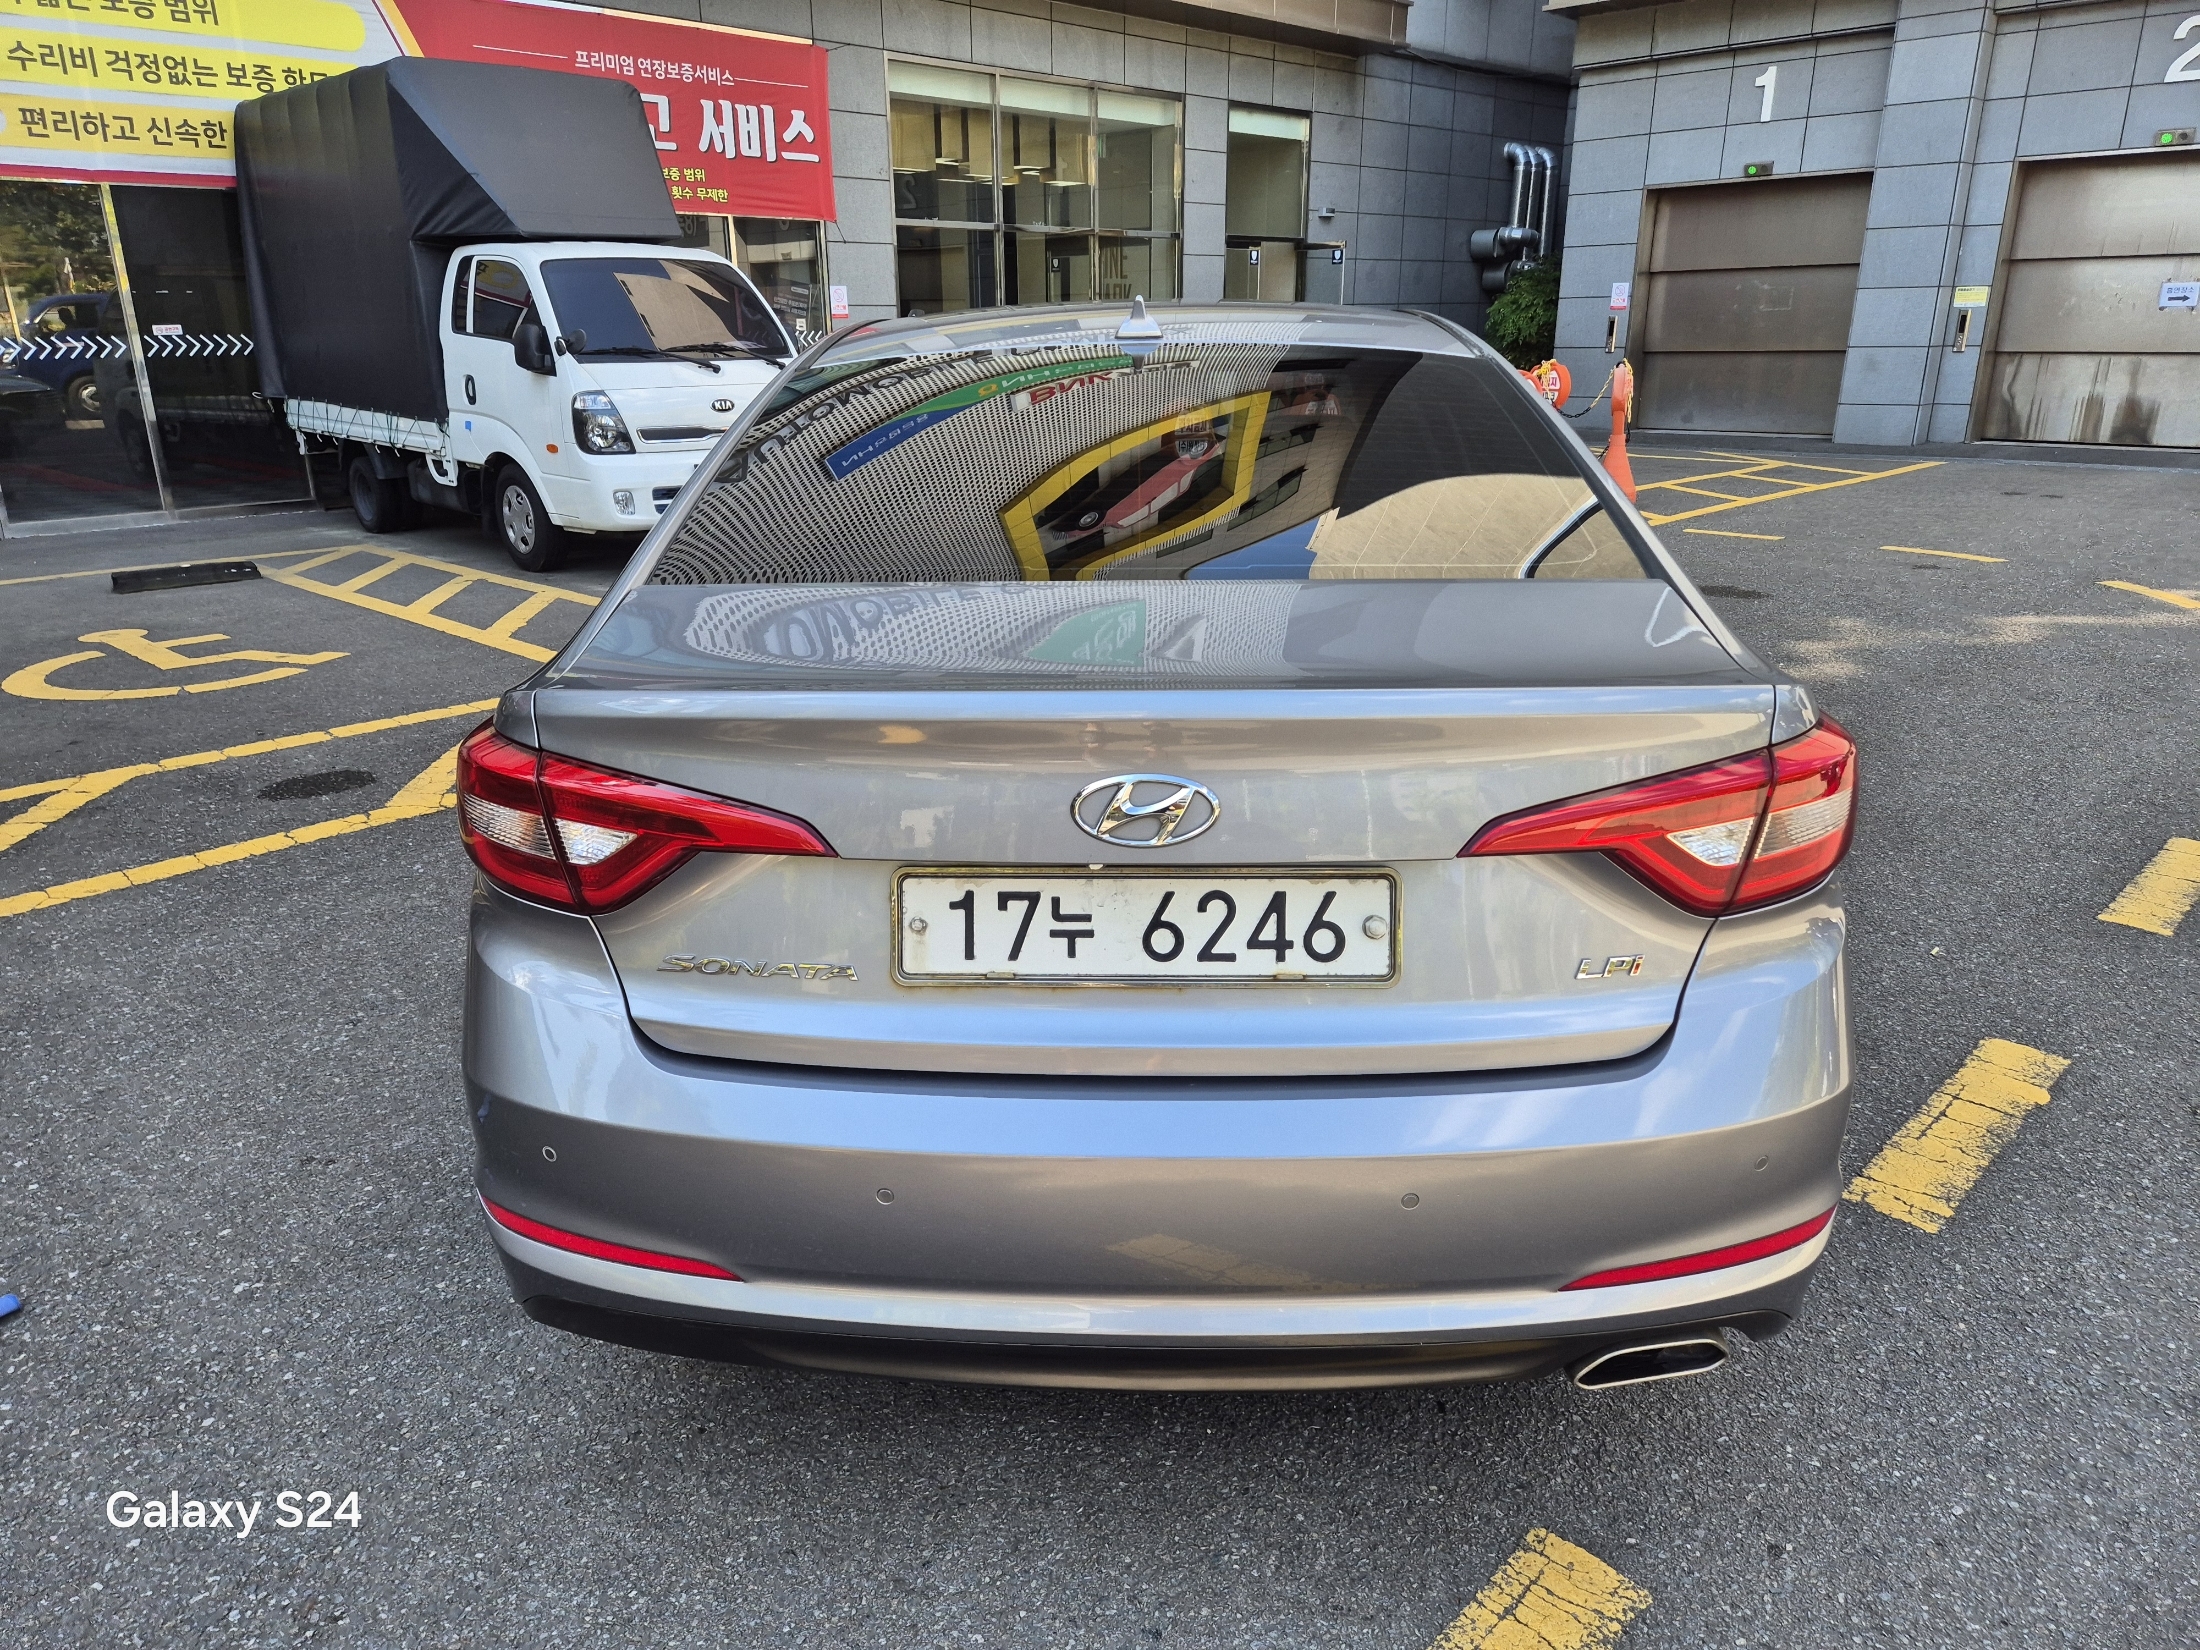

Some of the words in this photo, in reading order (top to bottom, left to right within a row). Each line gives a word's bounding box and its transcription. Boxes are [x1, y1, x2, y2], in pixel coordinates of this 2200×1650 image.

[164, 0, 220, 26] 범위
[7, 39, 99, 78] 수리비
[105, 47, 219, 89] 걱정없는
[226, 61, 277, 94] 보증
[2163, 14, 2200, 84] 2
[574, 50, 635, 76] 프리미엄
[637, 57, 735, 87] 연장보증서비스
[1754, 65, 1778, 123] 1
[18, 106, 141, 143] 편리하고
[146, 117, 228, 150] 신속한
[698, 98, 821, 163] 서비스
[683, 167, 706, 183] 범위
[671, 185, 694, 200] 횟수
[696, 187, 729, 203] 무제한
[713, 400, 733, 410] KIA
[949, 889, 1095, 961] 17누
[1141, 889, 1347, 963] 6246
[656, 953, 860, 981] SONATA
[1574, 953, 1646, 979] LPi
